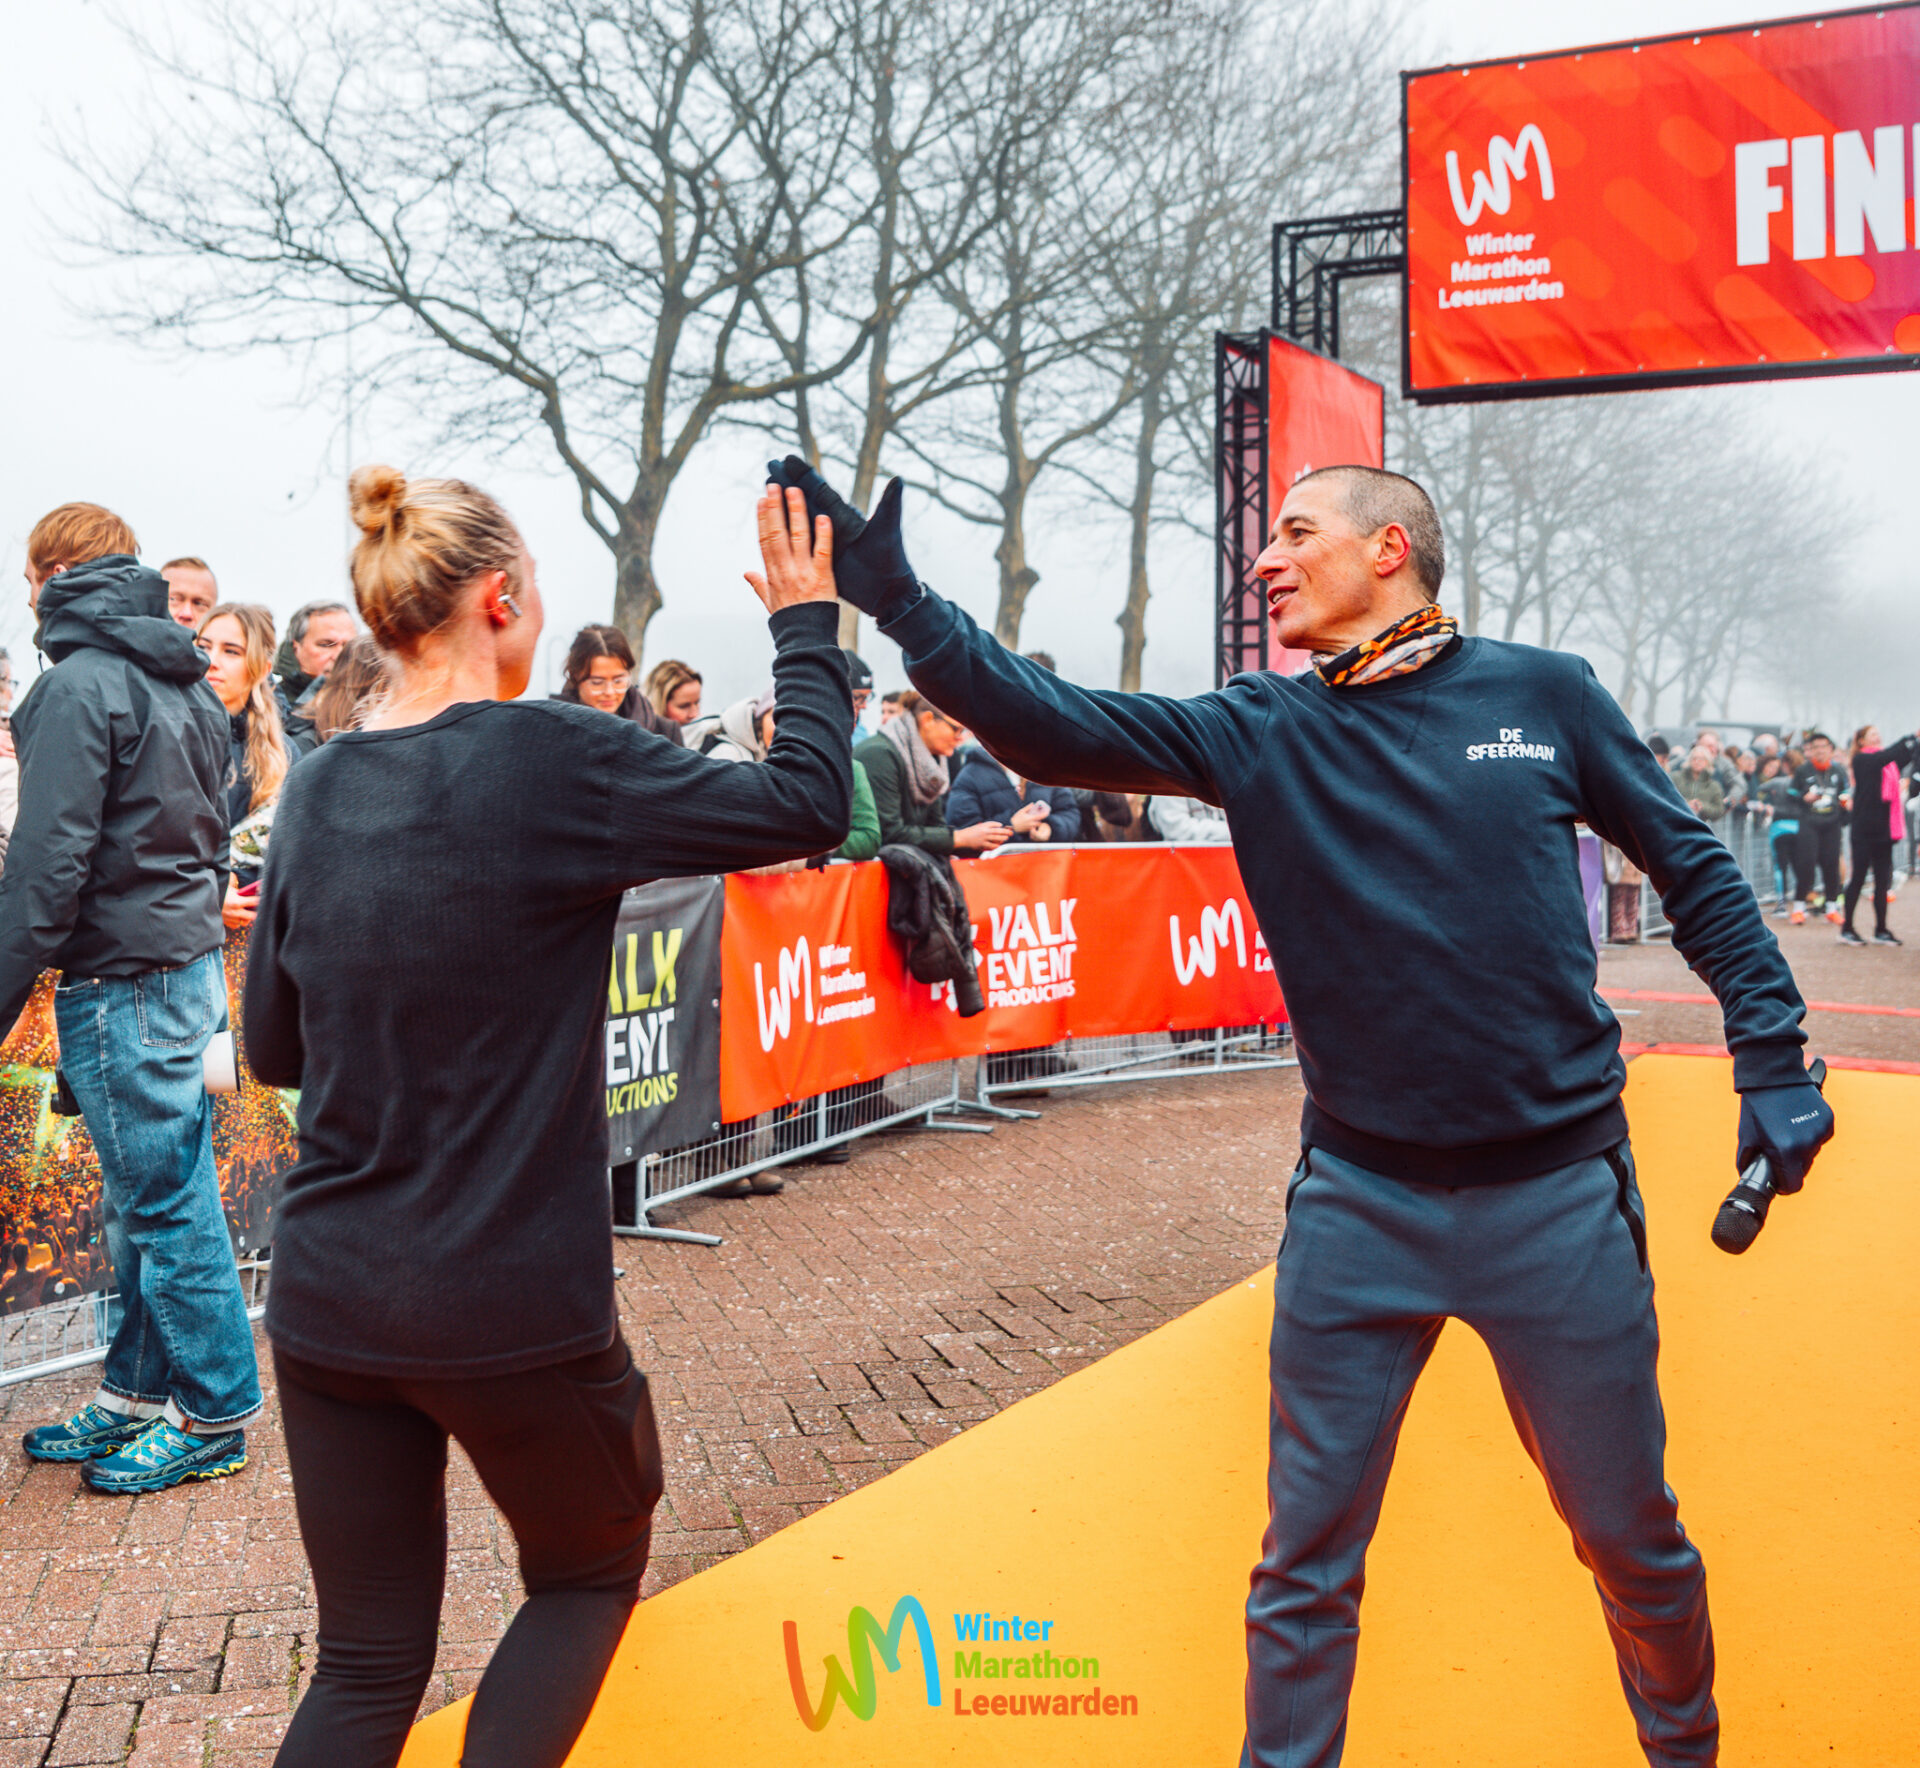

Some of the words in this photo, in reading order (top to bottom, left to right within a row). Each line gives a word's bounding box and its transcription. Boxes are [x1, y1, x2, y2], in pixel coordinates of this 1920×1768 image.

[1735, 122, 1920, 266] FIN
[1465, 232, 1535, 256] Winter
[1451, 254, 1550, 283] Marathon
[1438, 278, 1563, 309] Leeuwarden
[1466, 743, 1555, 761] SFEERMAN
[1499, 728, 1523, 742] DE
[988, 898, 1077, 950] VALK
[608, 928, 683, 1015] LK
[987, 944, 1077, 989] EVENT
[606, 1007, 675, 1085] ENT
[606, 1072, 678, 1118] UCTIONS
